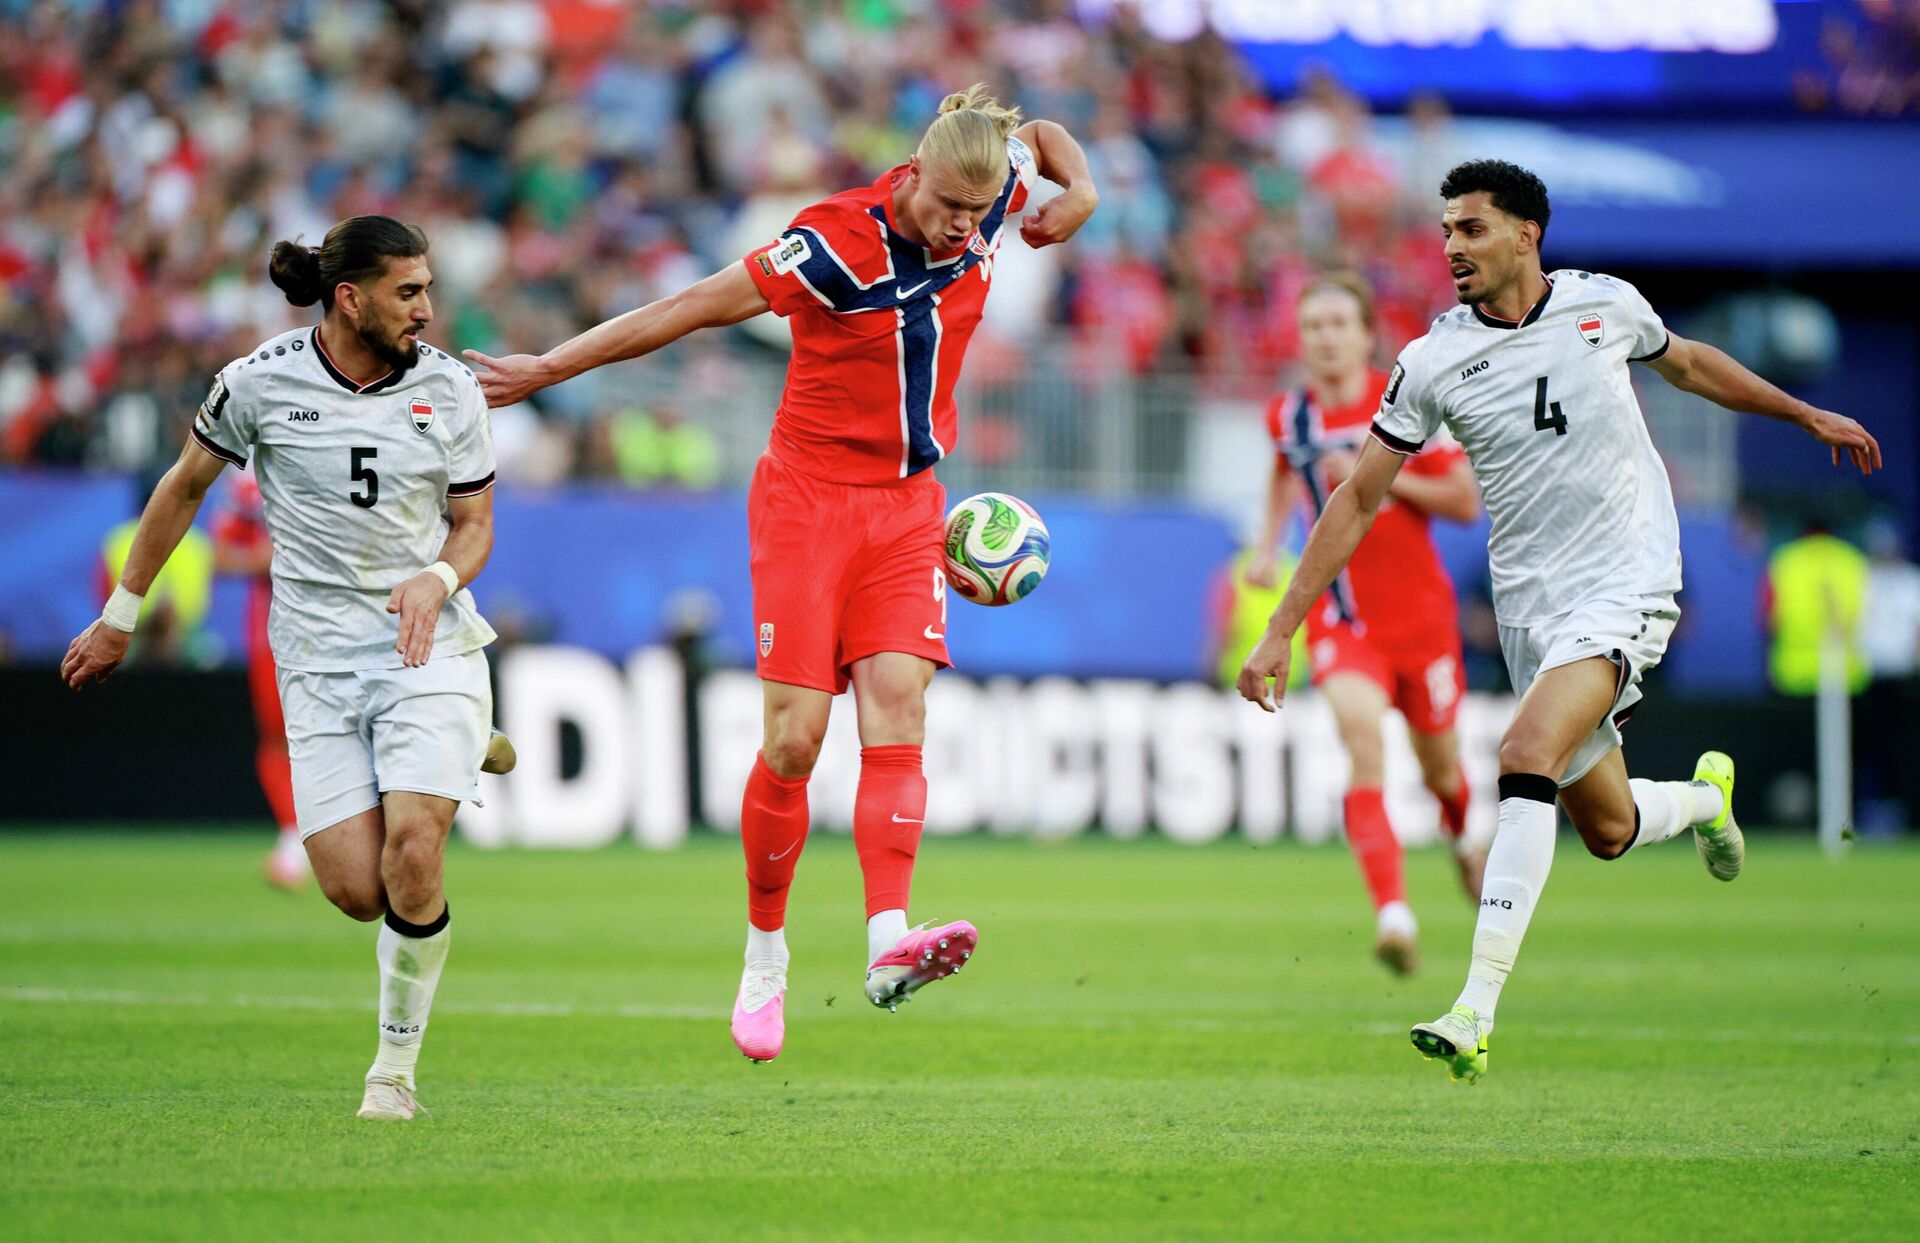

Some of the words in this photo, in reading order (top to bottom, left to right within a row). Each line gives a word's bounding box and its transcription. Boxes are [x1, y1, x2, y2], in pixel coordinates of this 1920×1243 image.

[1461, 360, 1489, 380] JAKO
[287, 411, 320, 421] JAKO
[1534, 376, 1568, 436] 4
[350, 447, 379, 508] 5
[933, 566, 947, 624] 9
[458, 645, 688, 848] DI
[1480, 898, 1512, 910] AKO
[382, 1023, 419, 1034] AKO
